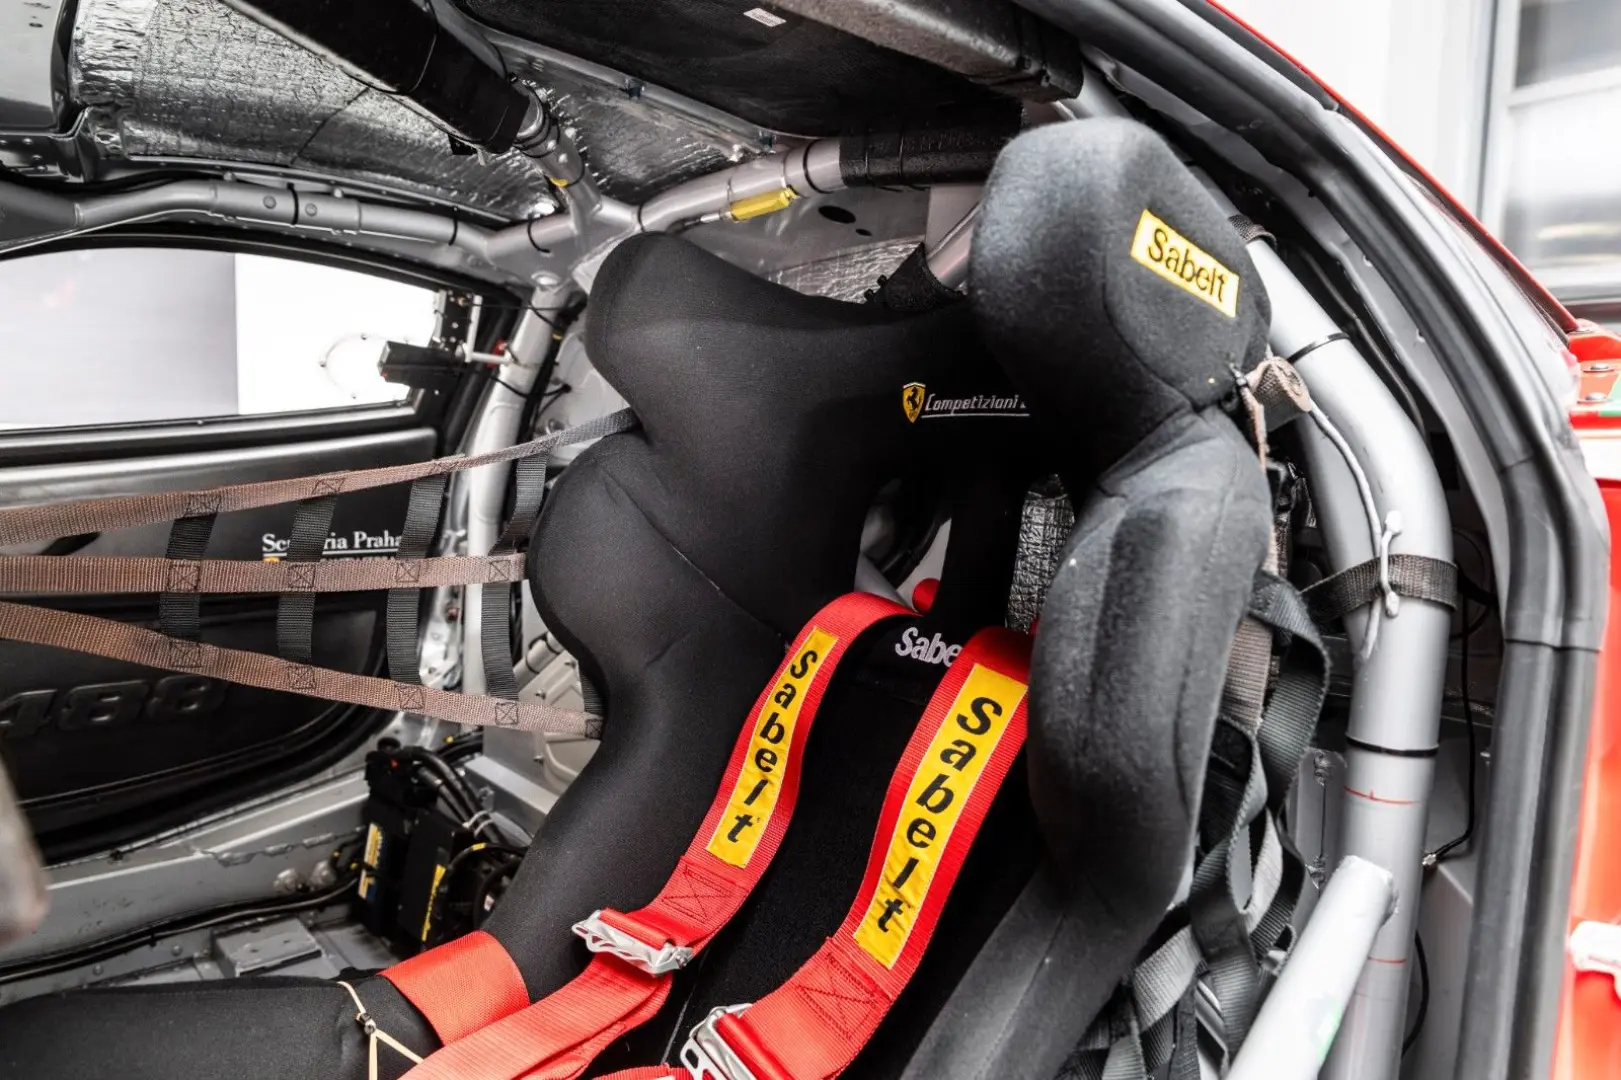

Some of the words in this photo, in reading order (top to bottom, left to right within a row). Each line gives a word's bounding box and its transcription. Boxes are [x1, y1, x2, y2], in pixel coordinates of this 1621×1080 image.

[1148, 228, 1225, 303] Sabelt
[925, 393, 1020, 414] Competizioni
[262, 531, 348, 552] Scria
[895, 627, 963, 668] Sabe
[726, 649, 818, 844] Sabelt
[877, 696, 1003, 933] Sabelt
